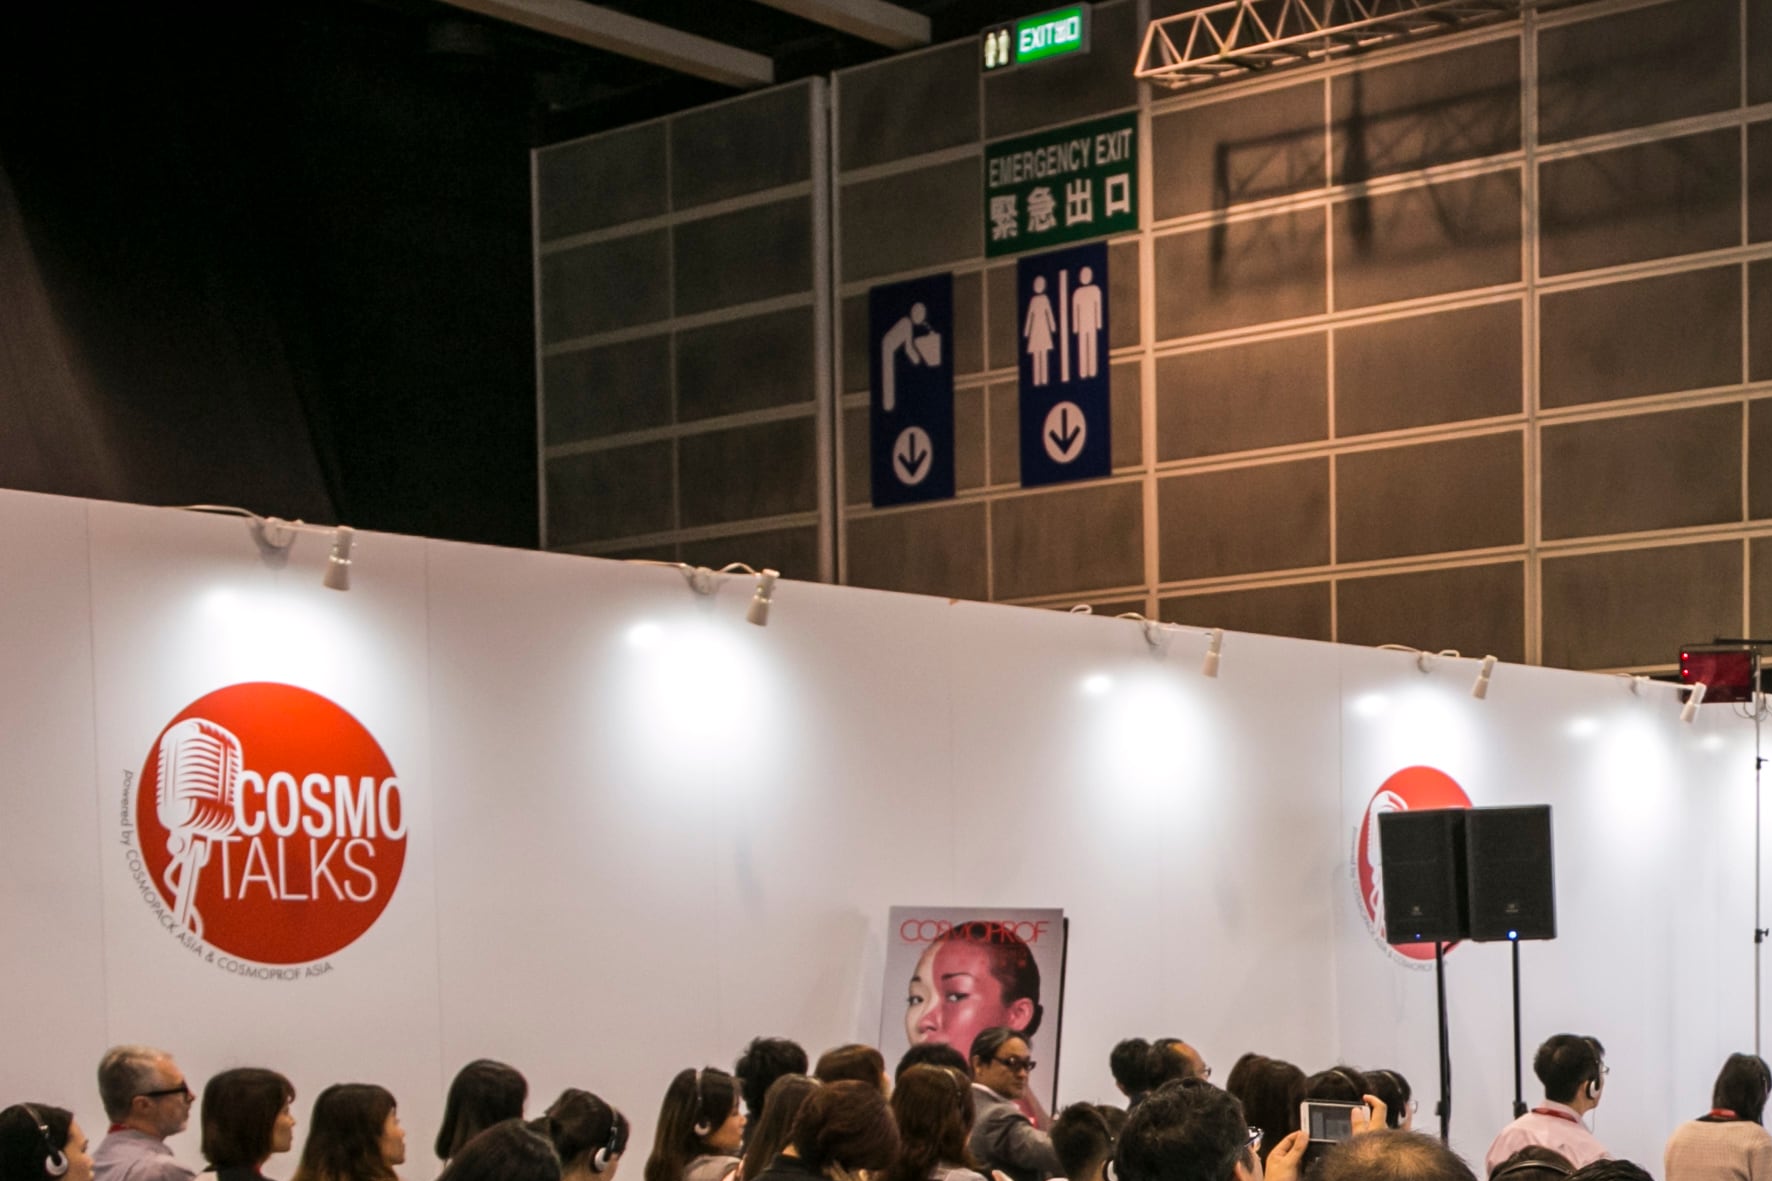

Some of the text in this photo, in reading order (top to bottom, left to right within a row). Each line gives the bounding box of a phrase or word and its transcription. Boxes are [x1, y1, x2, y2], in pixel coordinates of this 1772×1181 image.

[1019, 24, 1054, 53] EXIT
[989, 127, 1133, 188] EMERGENCY EXIT
[990, 173, 1131, 241] 緊急出口
[235, 770, 407, 841] COSMO
[213, 836, 378, 902] TALKS
[126, 848, 181, 934] COSMOPACK
[176, 930, 204, 957] ASIA
[205, 951, 214, 963] &
[217, 957, 302, 980] COSMOPROF
[304, 961, 335, 978] ASIA
[900, 919, 1049, 943] COSMOPROF
